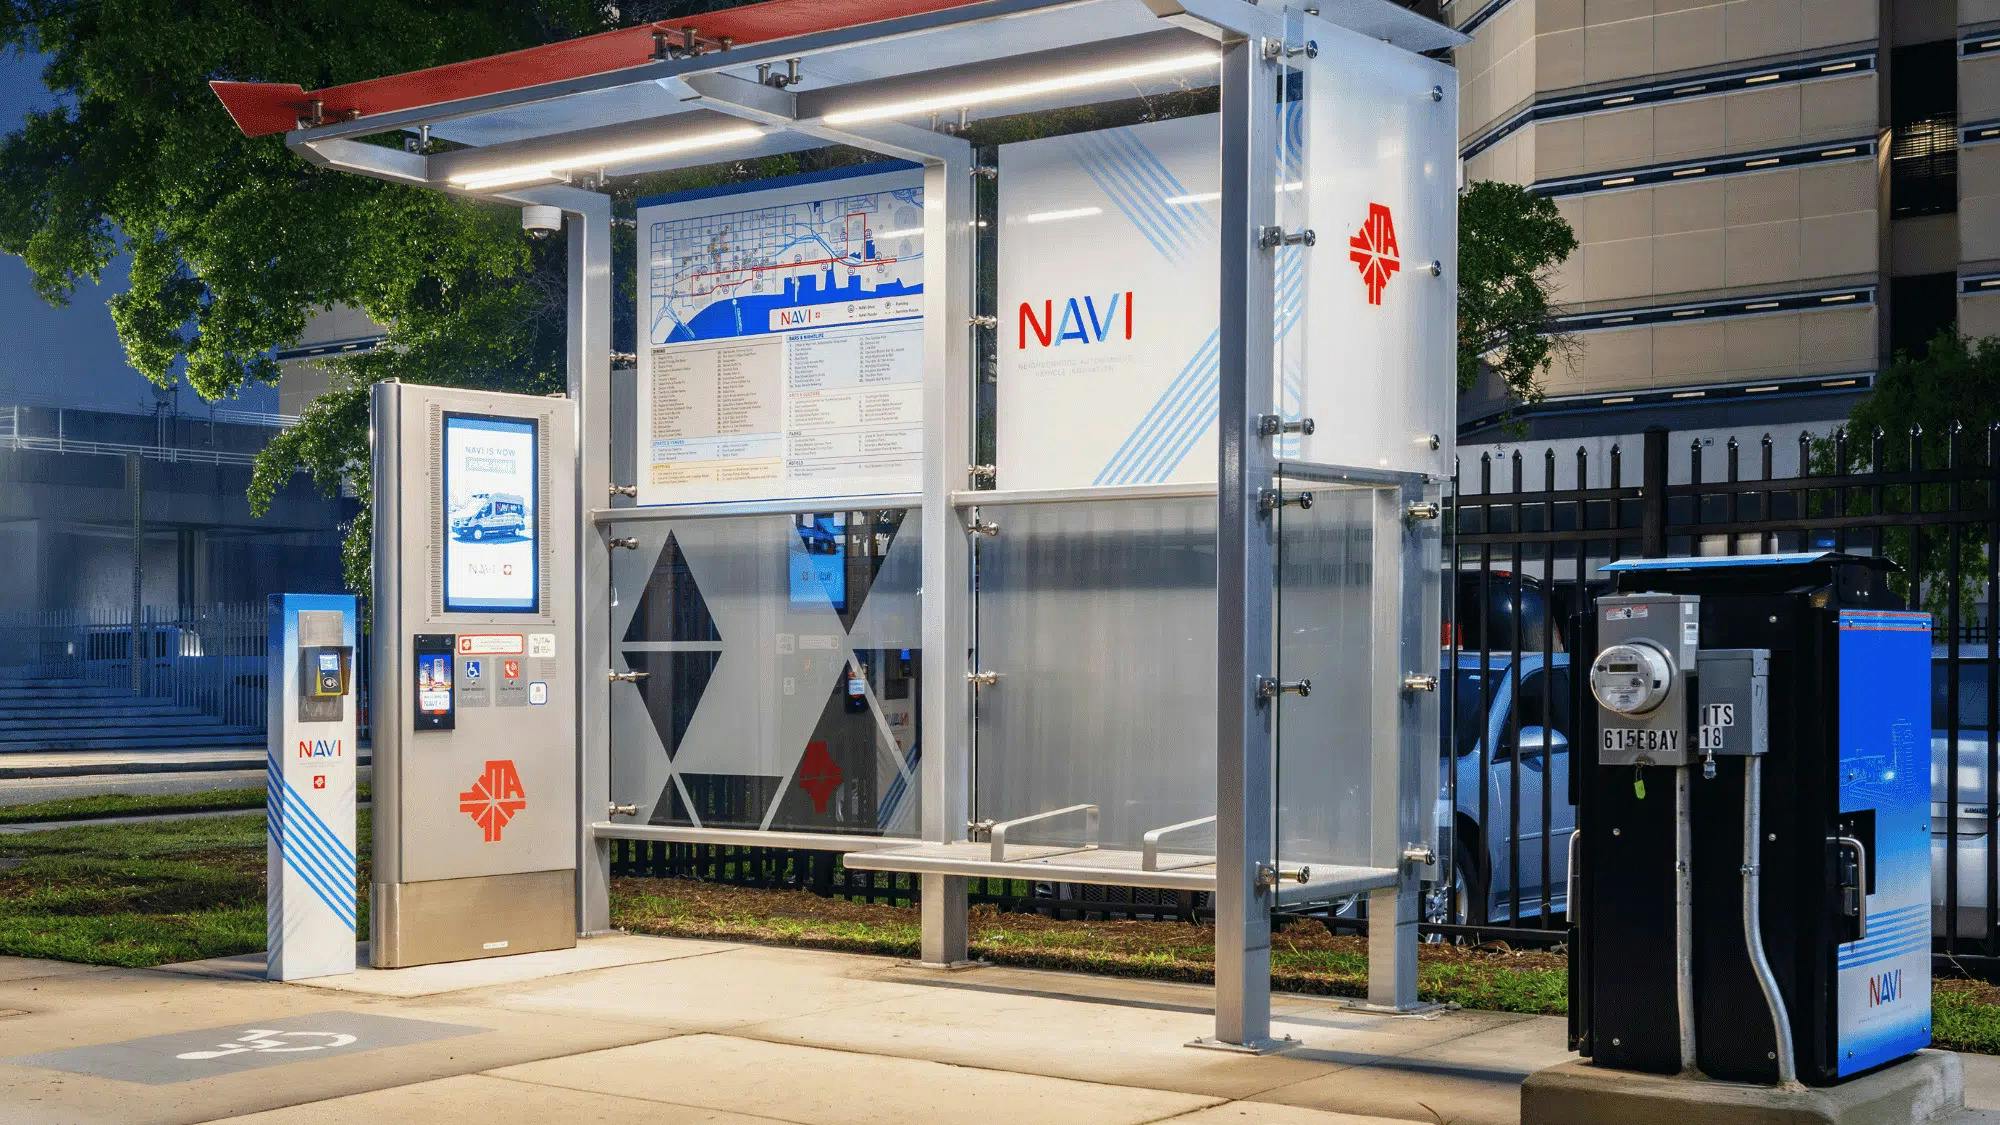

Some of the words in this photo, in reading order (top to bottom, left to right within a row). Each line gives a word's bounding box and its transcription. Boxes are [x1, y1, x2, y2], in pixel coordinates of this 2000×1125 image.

[780, 307, 812, 326] NAVI
[1018, 291, 1133, 349] NAVI
[1604, 730, 1678, 750] 615EBAY
[1702, 727, 1721, 747] 18
[299, 739, 342, 758] NAVI
[1869, 968, 1902, 1008] NAVI
